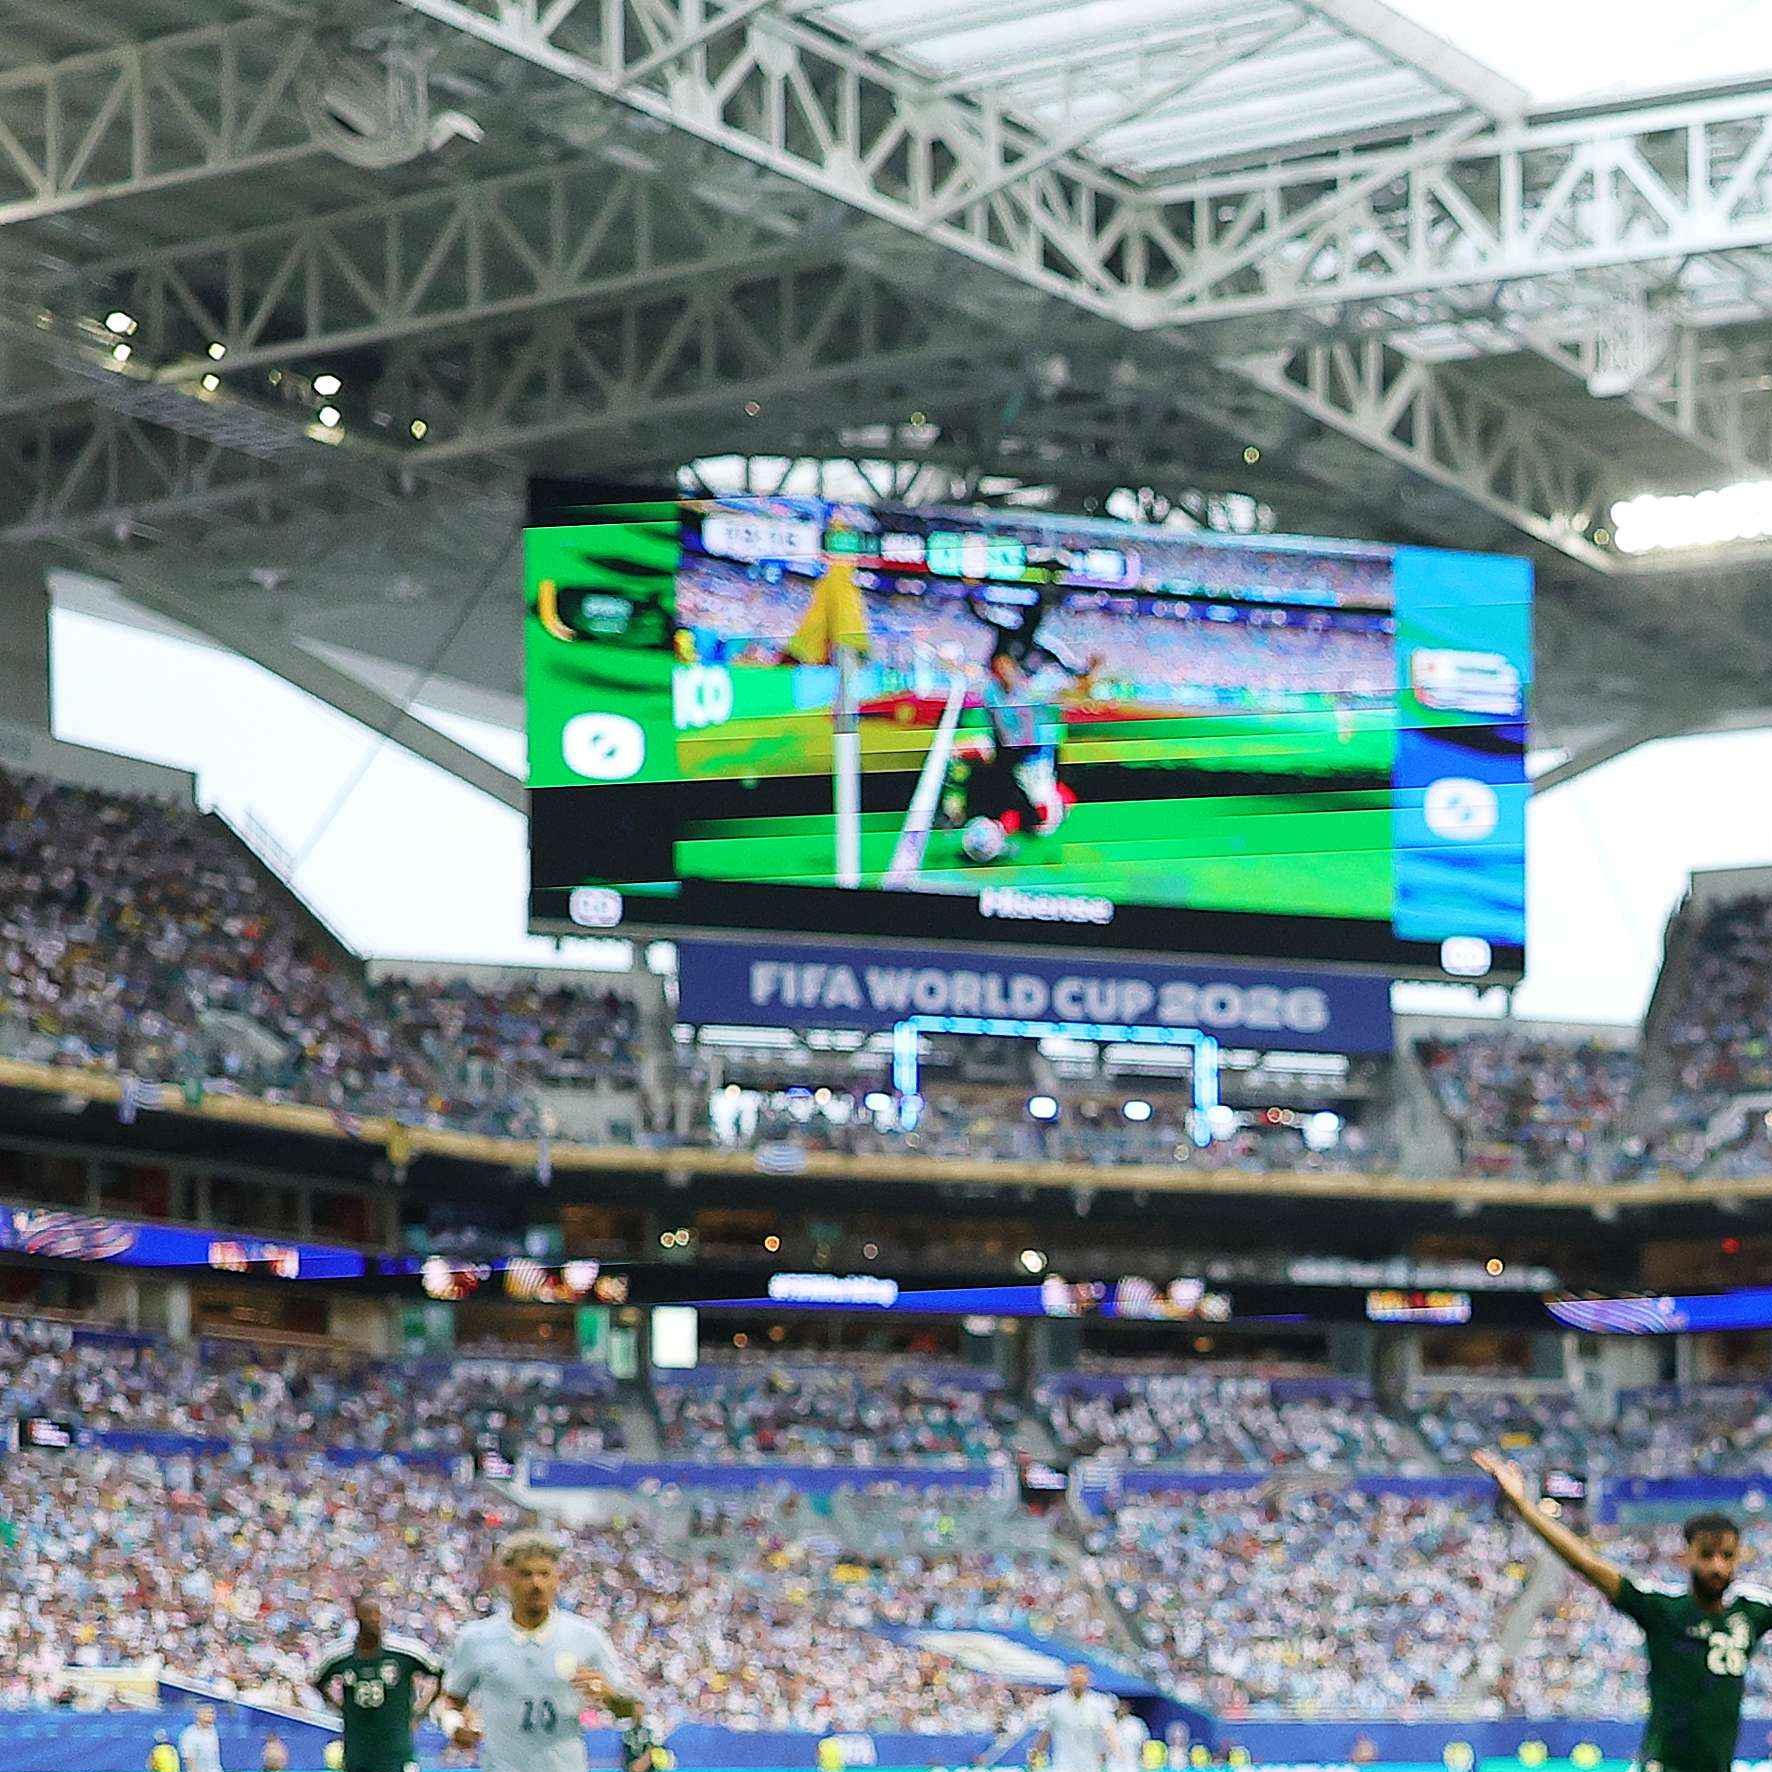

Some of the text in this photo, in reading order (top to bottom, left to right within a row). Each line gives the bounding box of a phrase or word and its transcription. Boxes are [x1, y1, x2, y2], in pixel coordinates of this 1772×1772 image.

[750, 961, 1329, 1033] FIFA WORLD CUP 2026
